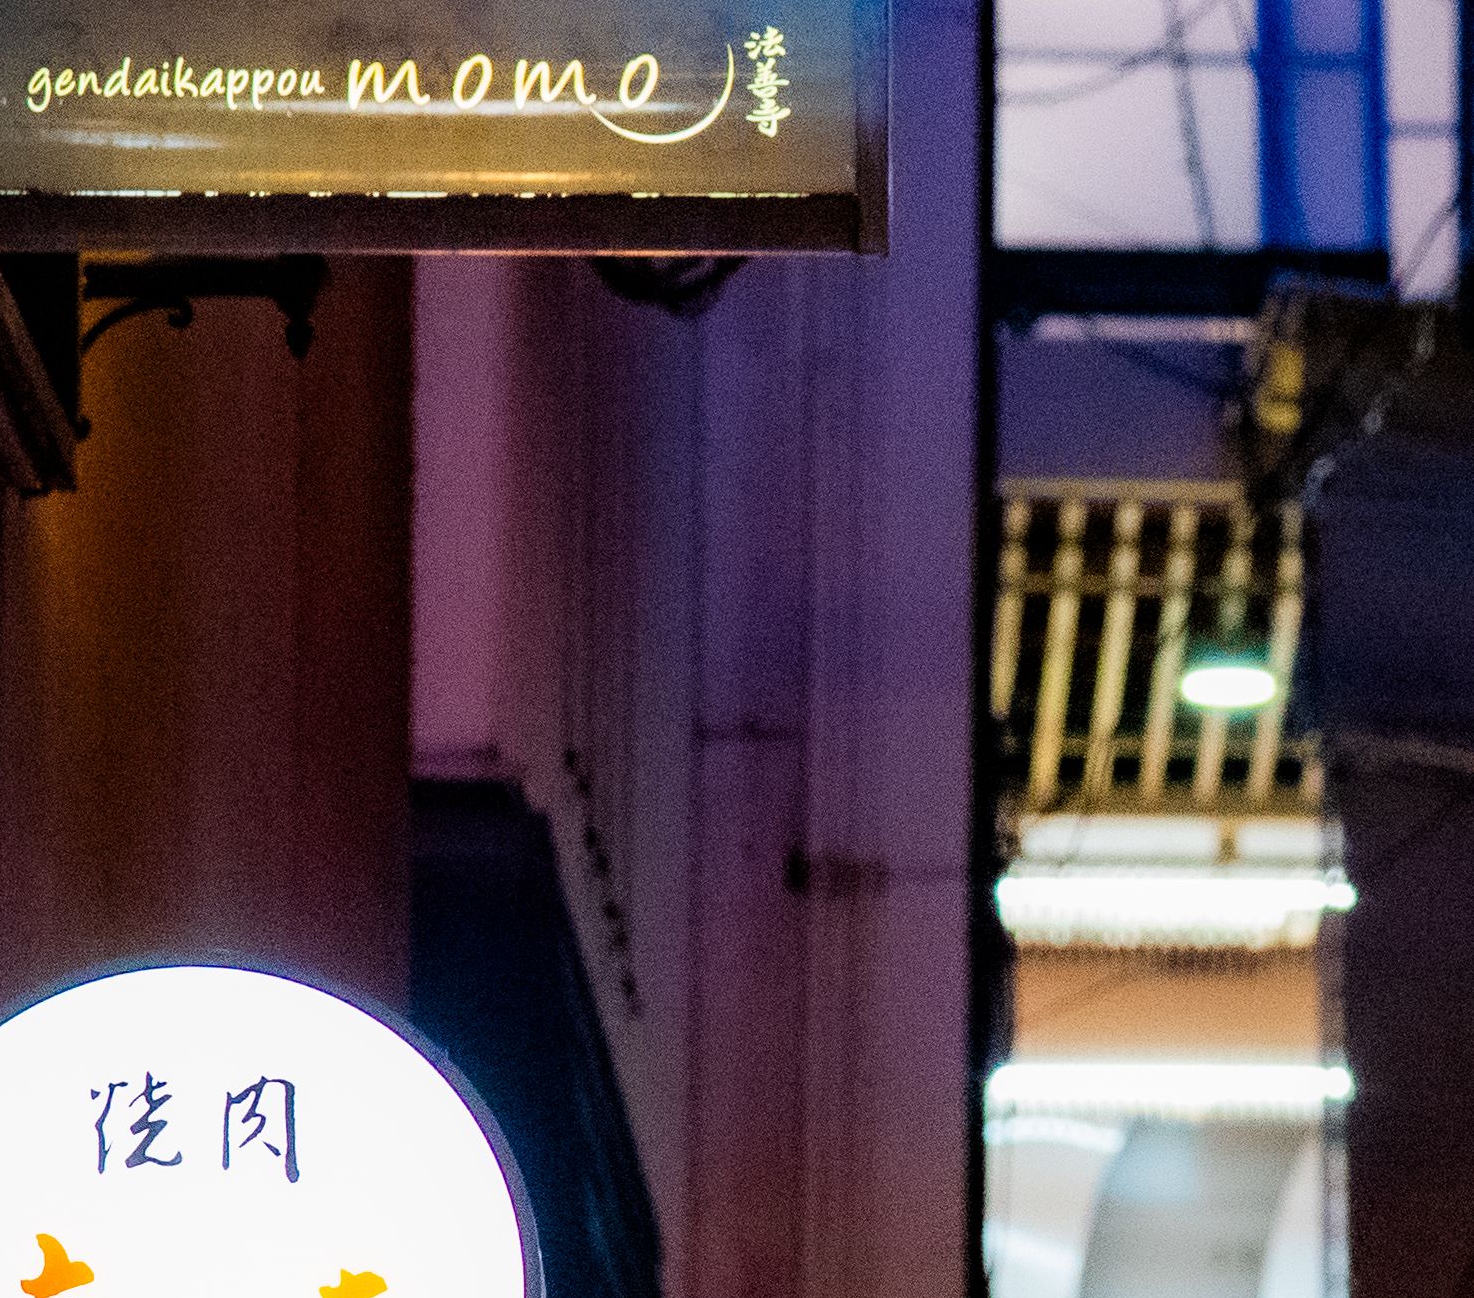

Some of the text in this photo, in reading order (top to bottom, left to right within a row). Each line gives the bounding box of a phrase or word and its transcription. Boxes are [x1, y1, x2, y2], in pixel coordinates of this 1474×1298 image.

[26, 53, 661, 114] gendaikappou momo
[743, 25, 792, 139] 法善寺
[89, 1071, 301, 1184] 焼肉
